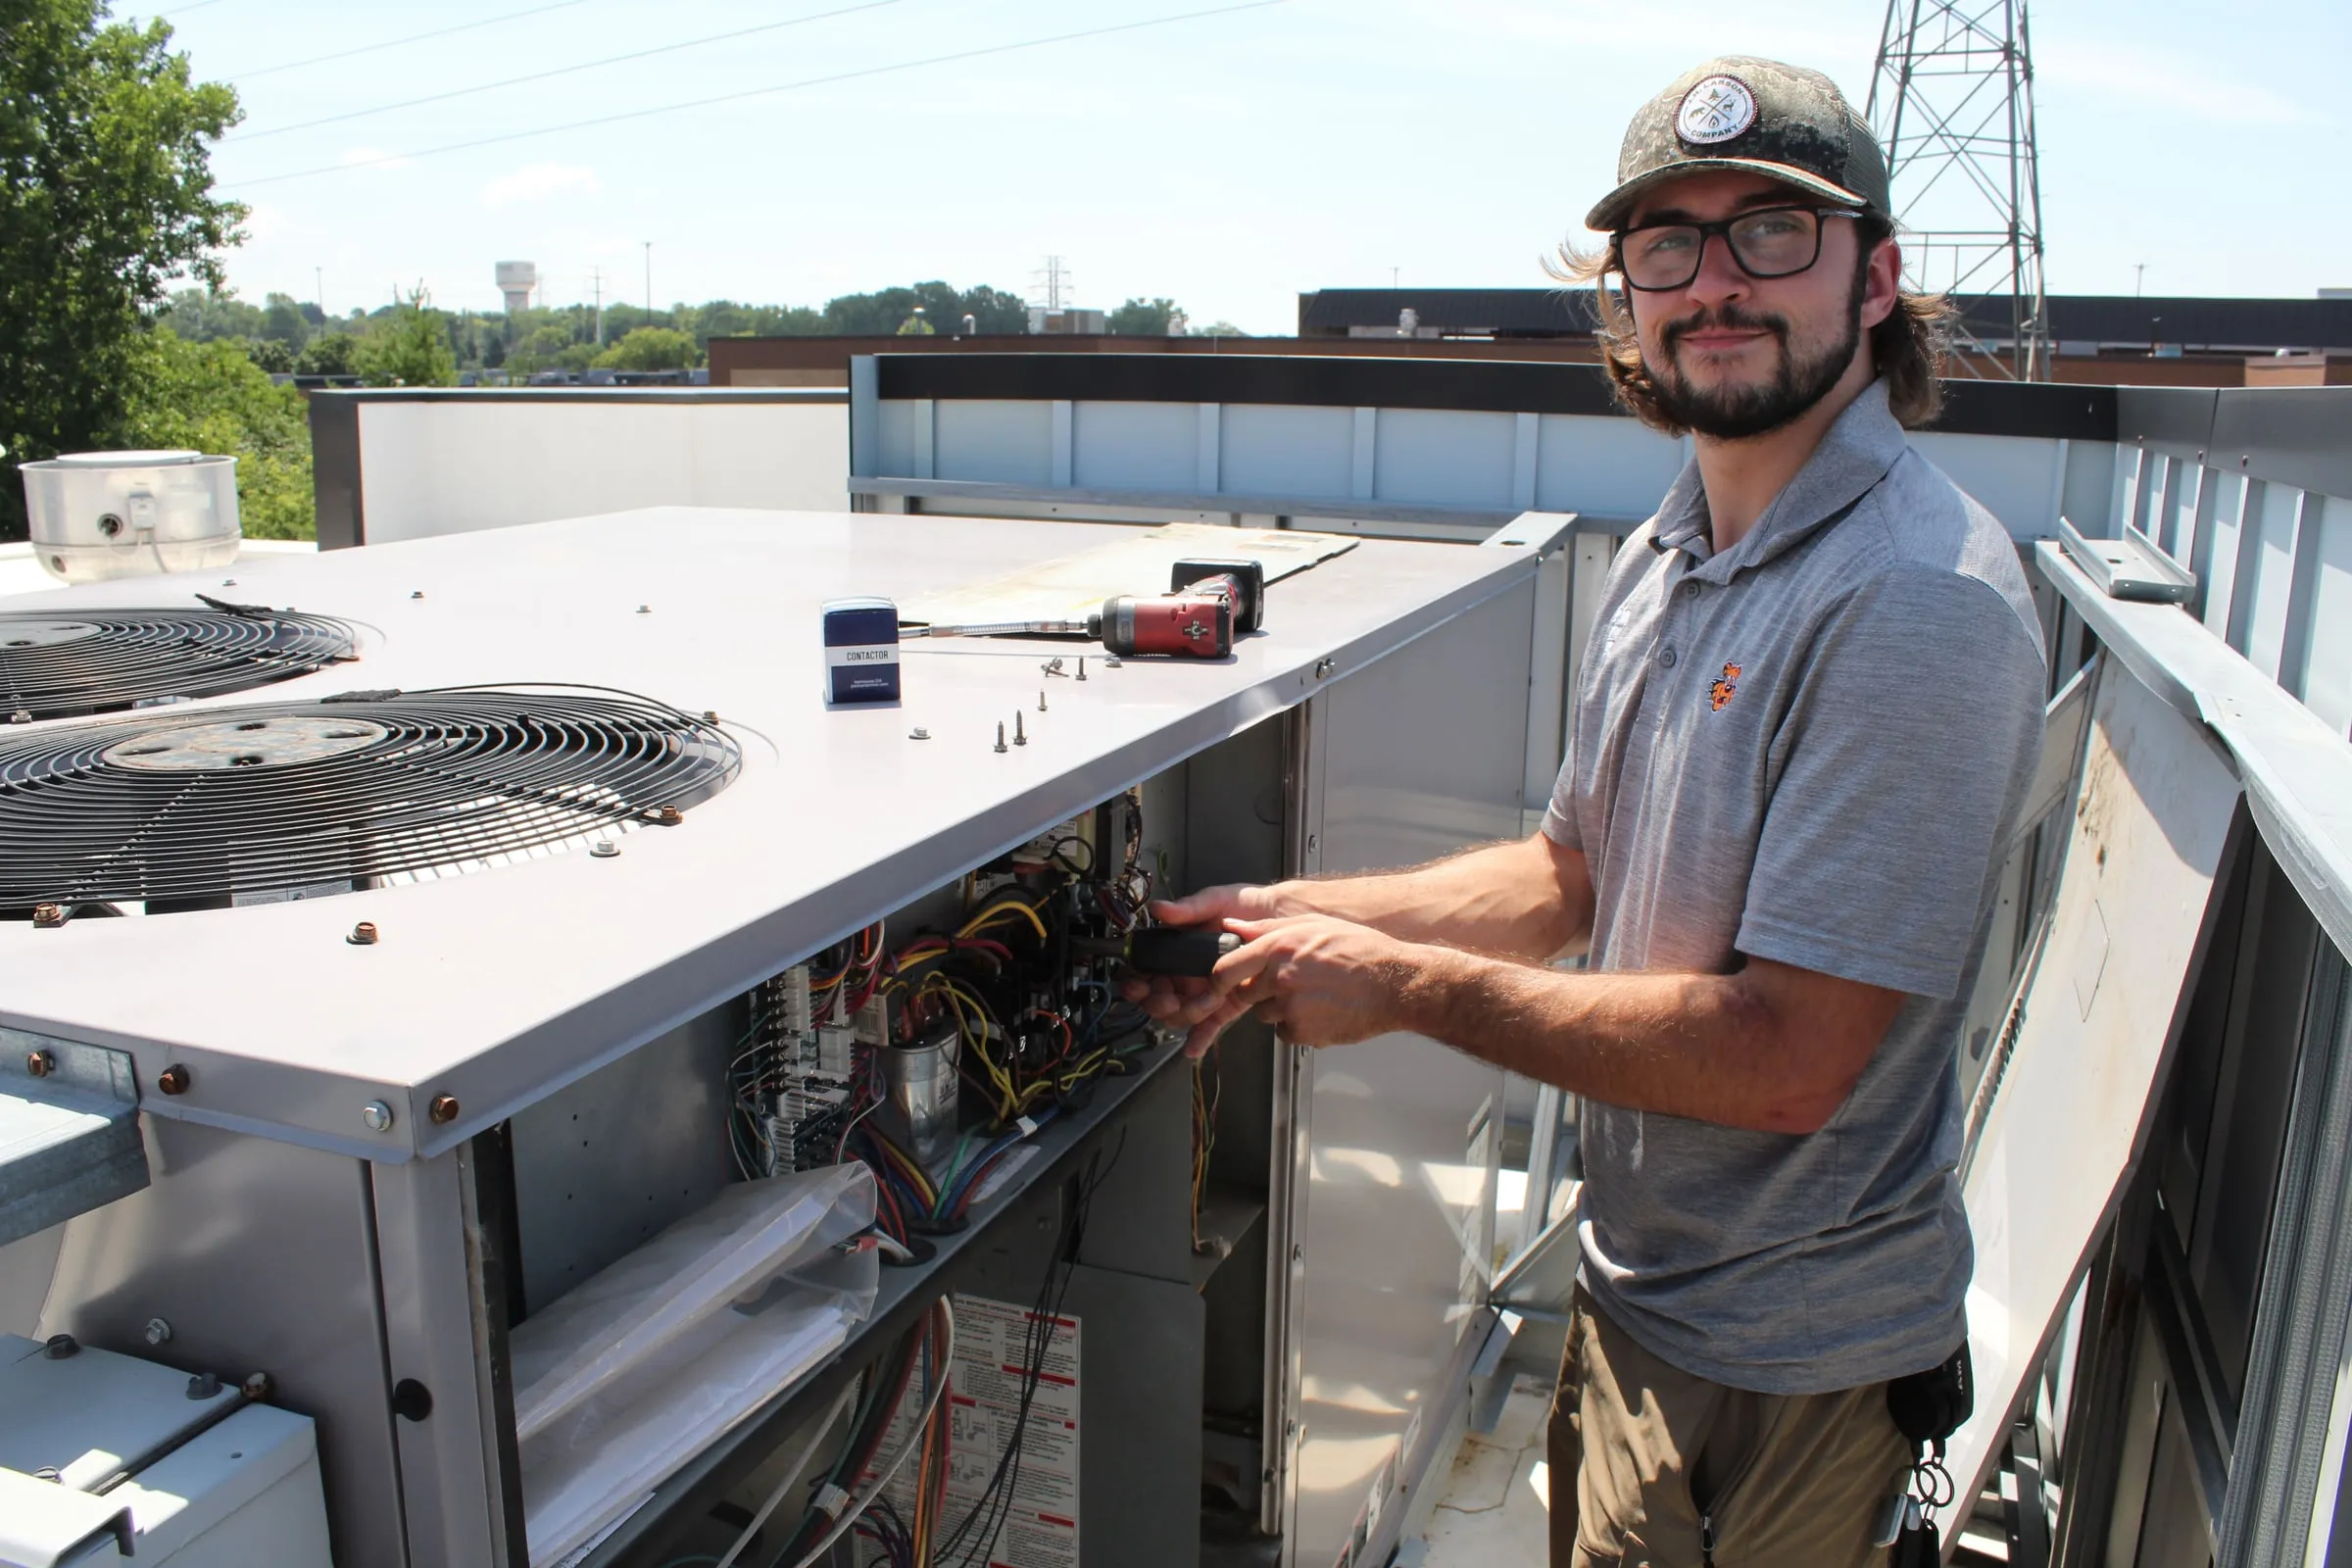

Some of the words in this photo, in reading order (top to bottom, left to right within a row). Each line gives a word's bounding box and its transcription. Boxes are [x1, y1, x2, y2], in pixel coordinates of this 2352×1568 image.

[1703, 79, 1744, 94] LARSON
[1690, 123, 1738, 138] COMPANY
[847, 651, 889, 662] CONTACTOR
